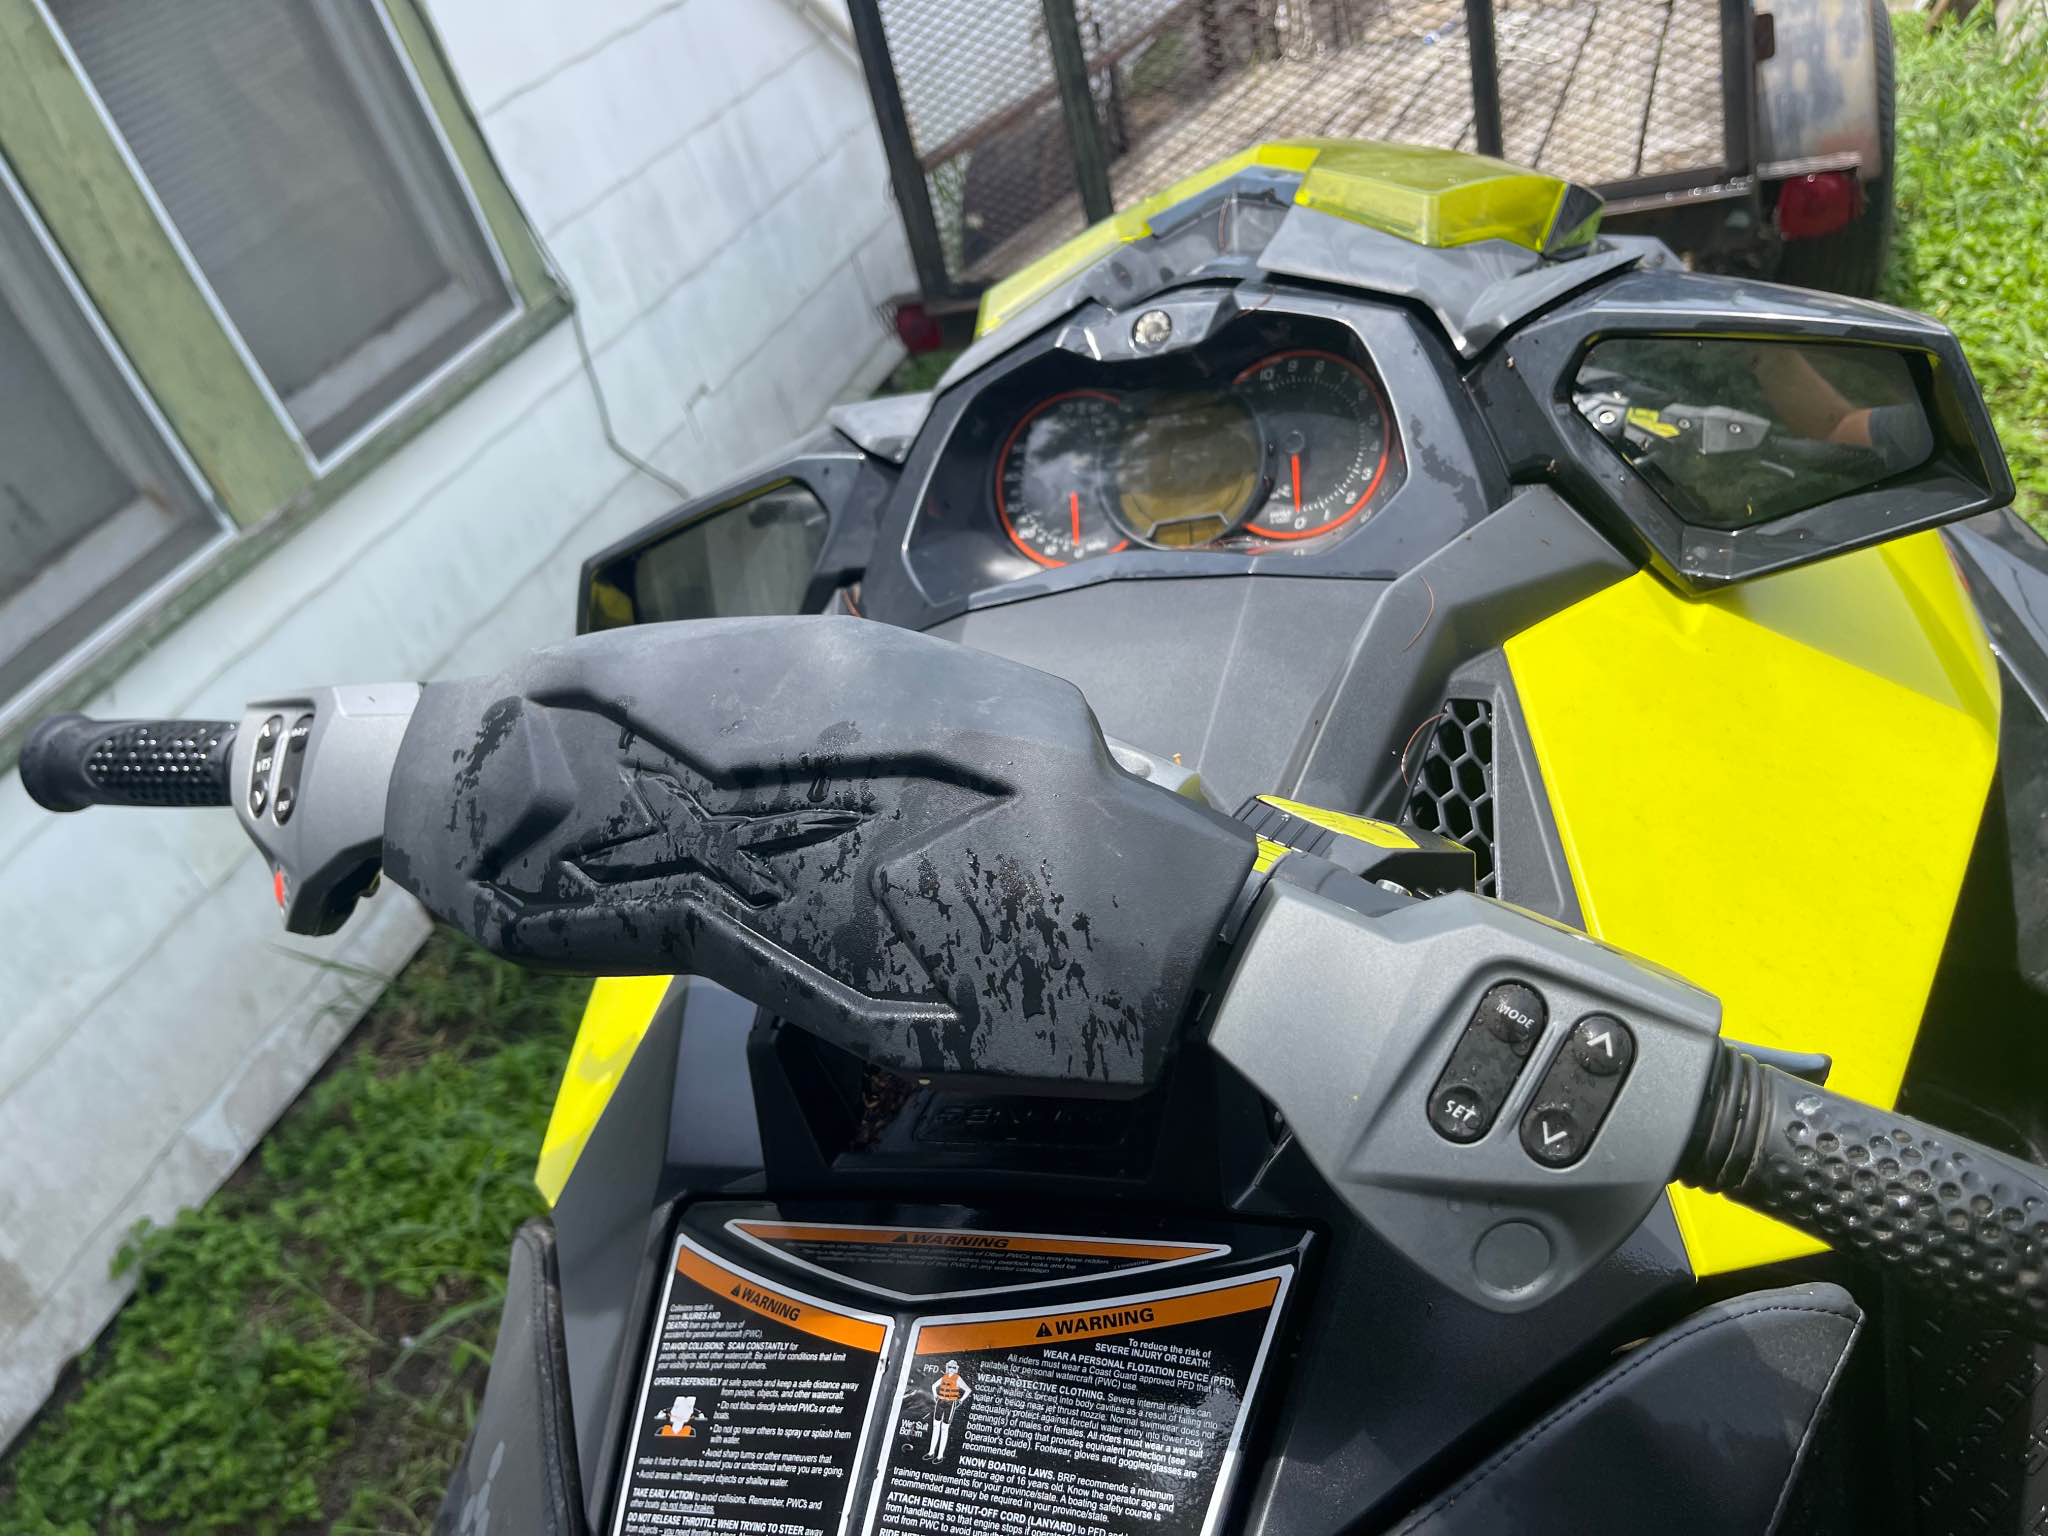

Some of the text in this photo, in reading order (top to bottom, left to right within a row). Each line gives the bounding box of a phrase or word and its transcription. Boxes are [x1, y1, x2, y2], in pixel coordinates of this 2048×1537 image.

[1294, 517, 1307, 530] 0
[1496, 1003, 1535, 1029] MODE
[1445, 1100, 1477, 1122] SET
[911, 1233, 1009, 1248] WARNING
[741, 1287, 801, 1321] WARNING
[1055, 1308, 1155, 1335] WARNING
[1095, 1342, 1211, 1367] SEVERE INJURY OR DEATH:
[1128, 1337, 1212, 1358] To reduce the risk of
[923, 1364, 939, 1373] PFD
[1041, 1358, 1060, 1368] must
[1061, 1362, 1079, 1372] wear
[1088, 1365, 1112, 1377] Coast
[1112, 1369, 1137, 1381] Guard
[1138, 1373, 1174, 1388] approved
[1176, 1379, 1194, 1390] PFD
[1043, 1348, 1069, 1360] WEAR
[1070, 1352, 1077, 1361] A
[1078, 1354, 1125, 1369] PERSONAL
[1127, 1361, 1175, 1376] FLOTATION
[1177, 1369, 1209, 1382] DEVICE
[799, 1379, 812, 1387] safe
[813, 1380, 840, 1388] distance
[841, 1382, 858, 1390] away
[977, 1372, 1002, 1384] WEAR
[1003, 1376, 1057, 1392] PROTECTIVE
[1107, 1393, 1135, 1405] Severe
[962, 1440, 1018, 1457] recommended.
[966, 1420, 1187, 1465] bottom or clothing that provides equivalent protection (see
[958, 1455, 986, 1467] KNOW
[987, 1460, 1026, 1474] BOATING
[1057, 1472, 1076, 1483] BRP
[1077, 1475, 1129, 1492] recommends
[1137, 1486, 1174, 1500] minimum
[1073, 1449, 1100, 1463] gloves
[1101, 1454, 1116, 1464] and
[1183, 1469, 1197, 1478] are
[890, 1475, 944, 1492] recommended
[944, 1485, 960, 1495] and
[960, 1489, 976, 1500] may
[978, 1491, 989, 1500] be
[990, 1493, 1022, 1508] required
[1024, 1498, 1032, 1507] in
[1032, 1502, 1050, 1512] your
[892, 1464, 922, 1479] training
[922, 1470, 970, 1488] requirements
[971, 1478, 982, 1488] for
[983, 1482, 1001, 1493] your
[1059, 1494, 1067, 1503] A
[1067, 1496, 1097, 1510] boating
[1098, 1501, 1123, 1515] safety
[1124, 1507, 1151, 1518] course
[1153, 1511, 1161, 1520] is
[956, 1464, 1174, 1512] operator age of 16 years old. Know the operator age and
[651, 1515, 681, 1525] RELEASE
[682, 1517, 717, 1528] THROTTLE
[717, 1520, 739, 1529] WHEN
[740, 1522, 767, 1532] TRYING
[768, 1524, 779, 1533] TO
[780, 1525, 804, 1535] STEER
[887, 1491, 1106, 1536] ATTACH ENGINE SHUT-OFF CORD (LANYARD) to PFD
